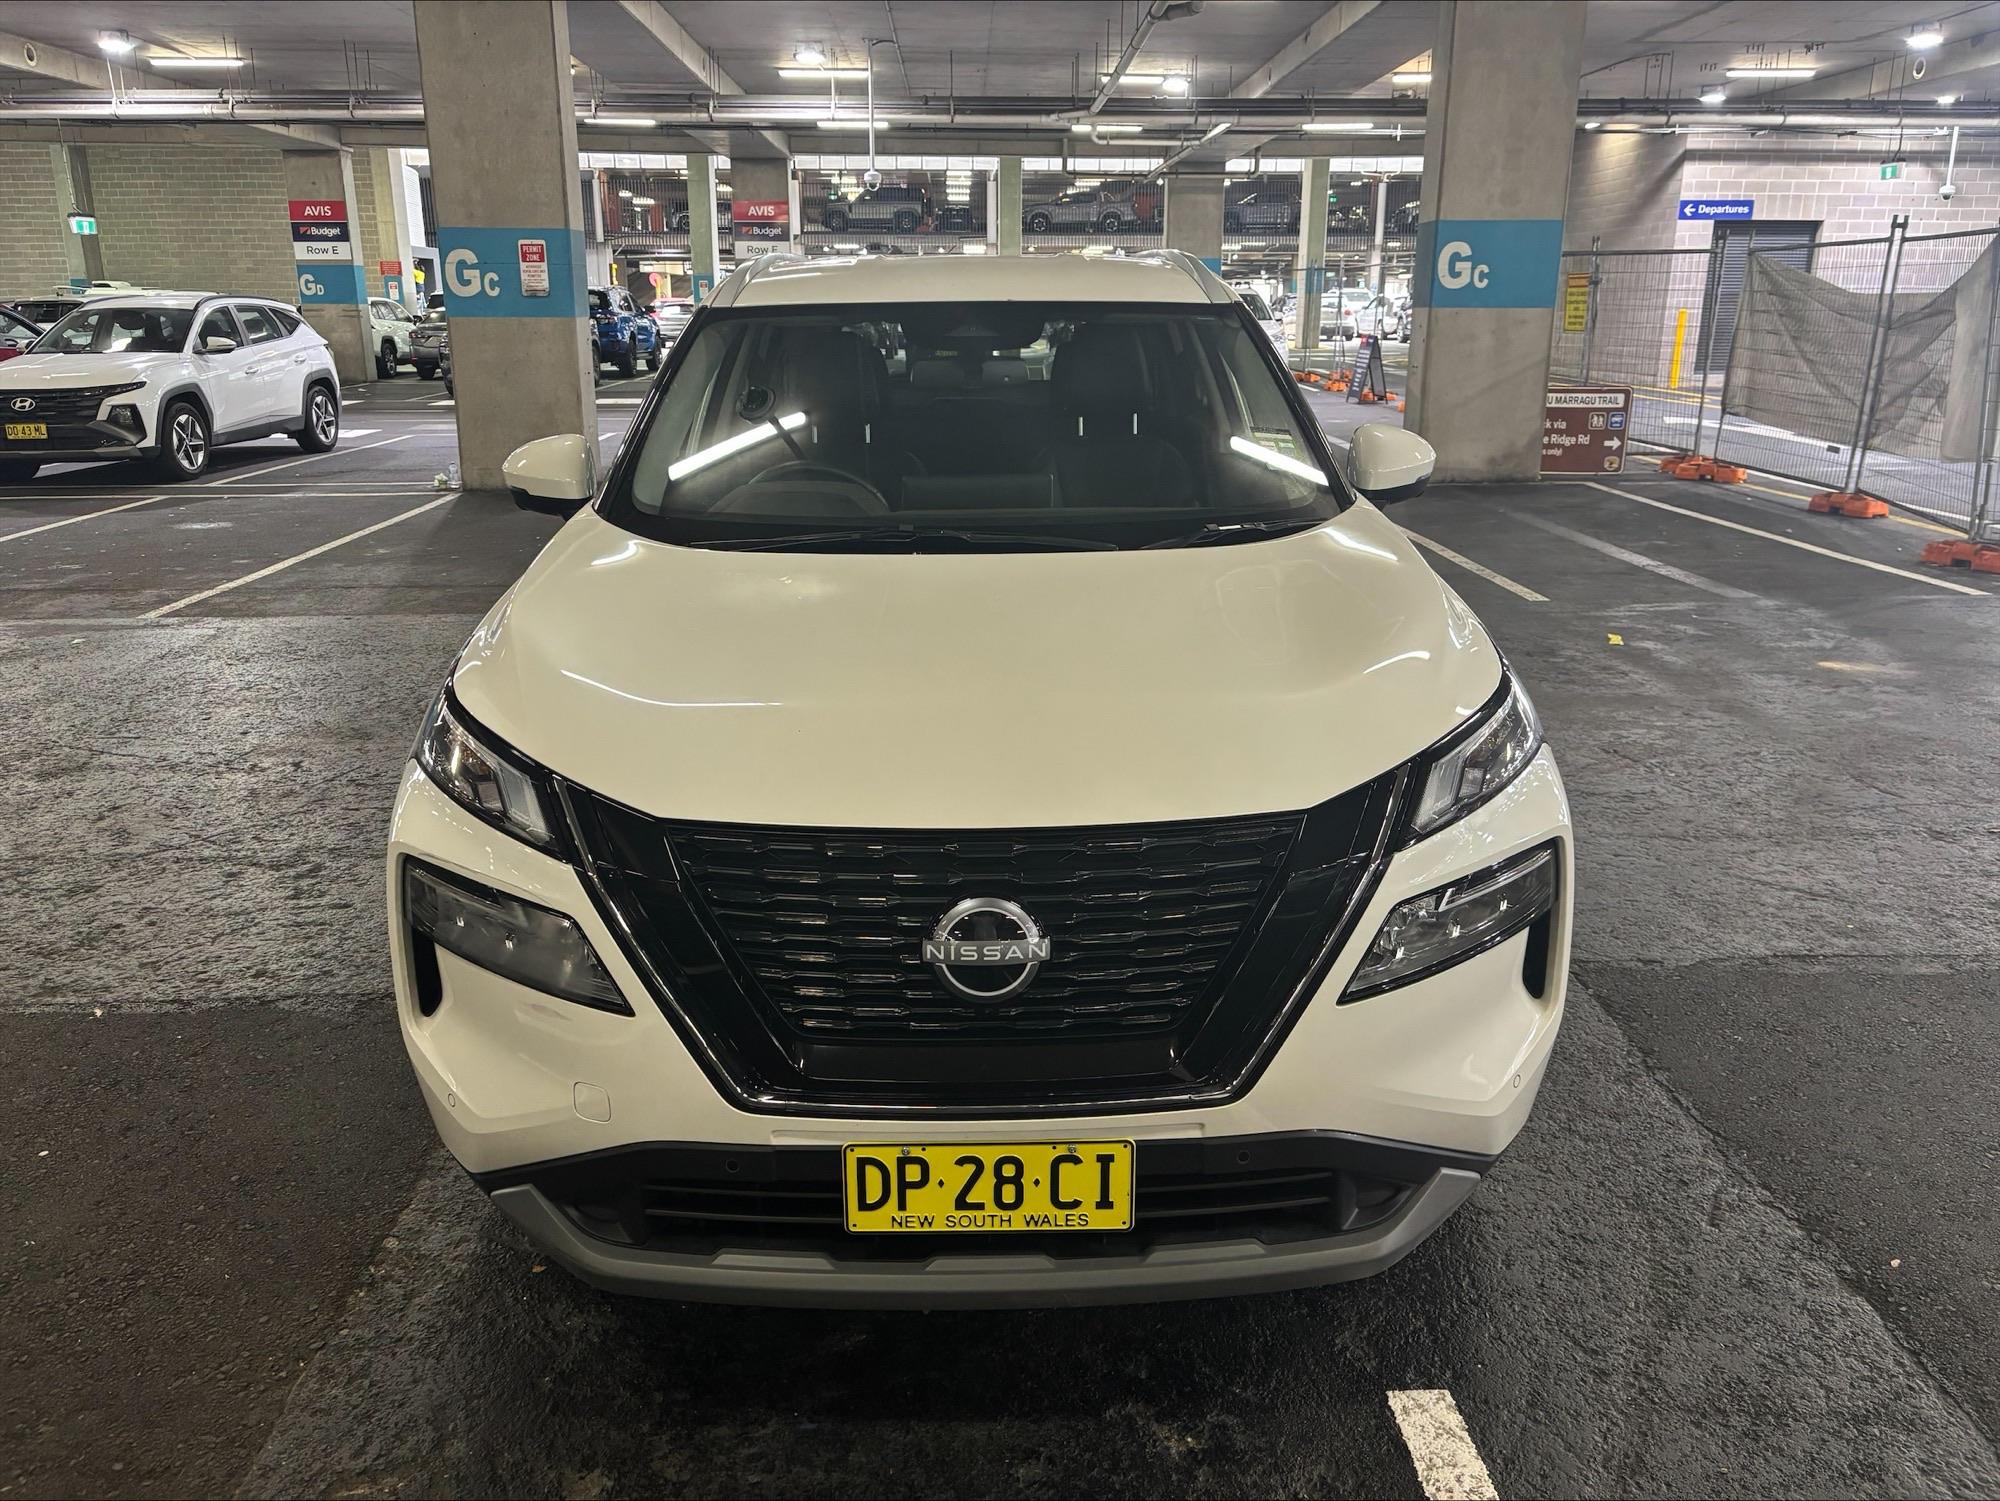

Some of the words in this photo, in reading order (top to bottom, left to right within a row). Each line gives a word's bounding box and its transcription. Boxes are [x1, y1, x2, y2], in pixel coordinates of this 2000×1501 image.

[304, 206, 332, 216] AVIS
[748, 205, 775, 216] AVIS
[1698, 204, 1750, 216] Departures
[311, 226, 341, 237] Budget
[753, 226, 782, 237] Budget
[306, 246, 329, 254] Row
[332, 246, 339, 254] E
[522, 245, 542, 253] PERMIT
[747, 245, 769, 254] Row
[526, 253, 541, 261] ZONE
[1555, 396, 1597, 405] MARRAGU
[1598, 396, 1620, 405] TRAIL
[1553, 419, 1567, 429] via
[1550, 434, 1577, 447] Ridge
[1578, 434, 1590, 445] Rd
[926, 942, 1047, 961] NISSAN
[891, 1214, 935, 1228] NEW
[945, 1214, 1012, 1228] SOUTH
[1023, 1213, 1089, 1227] WALES
